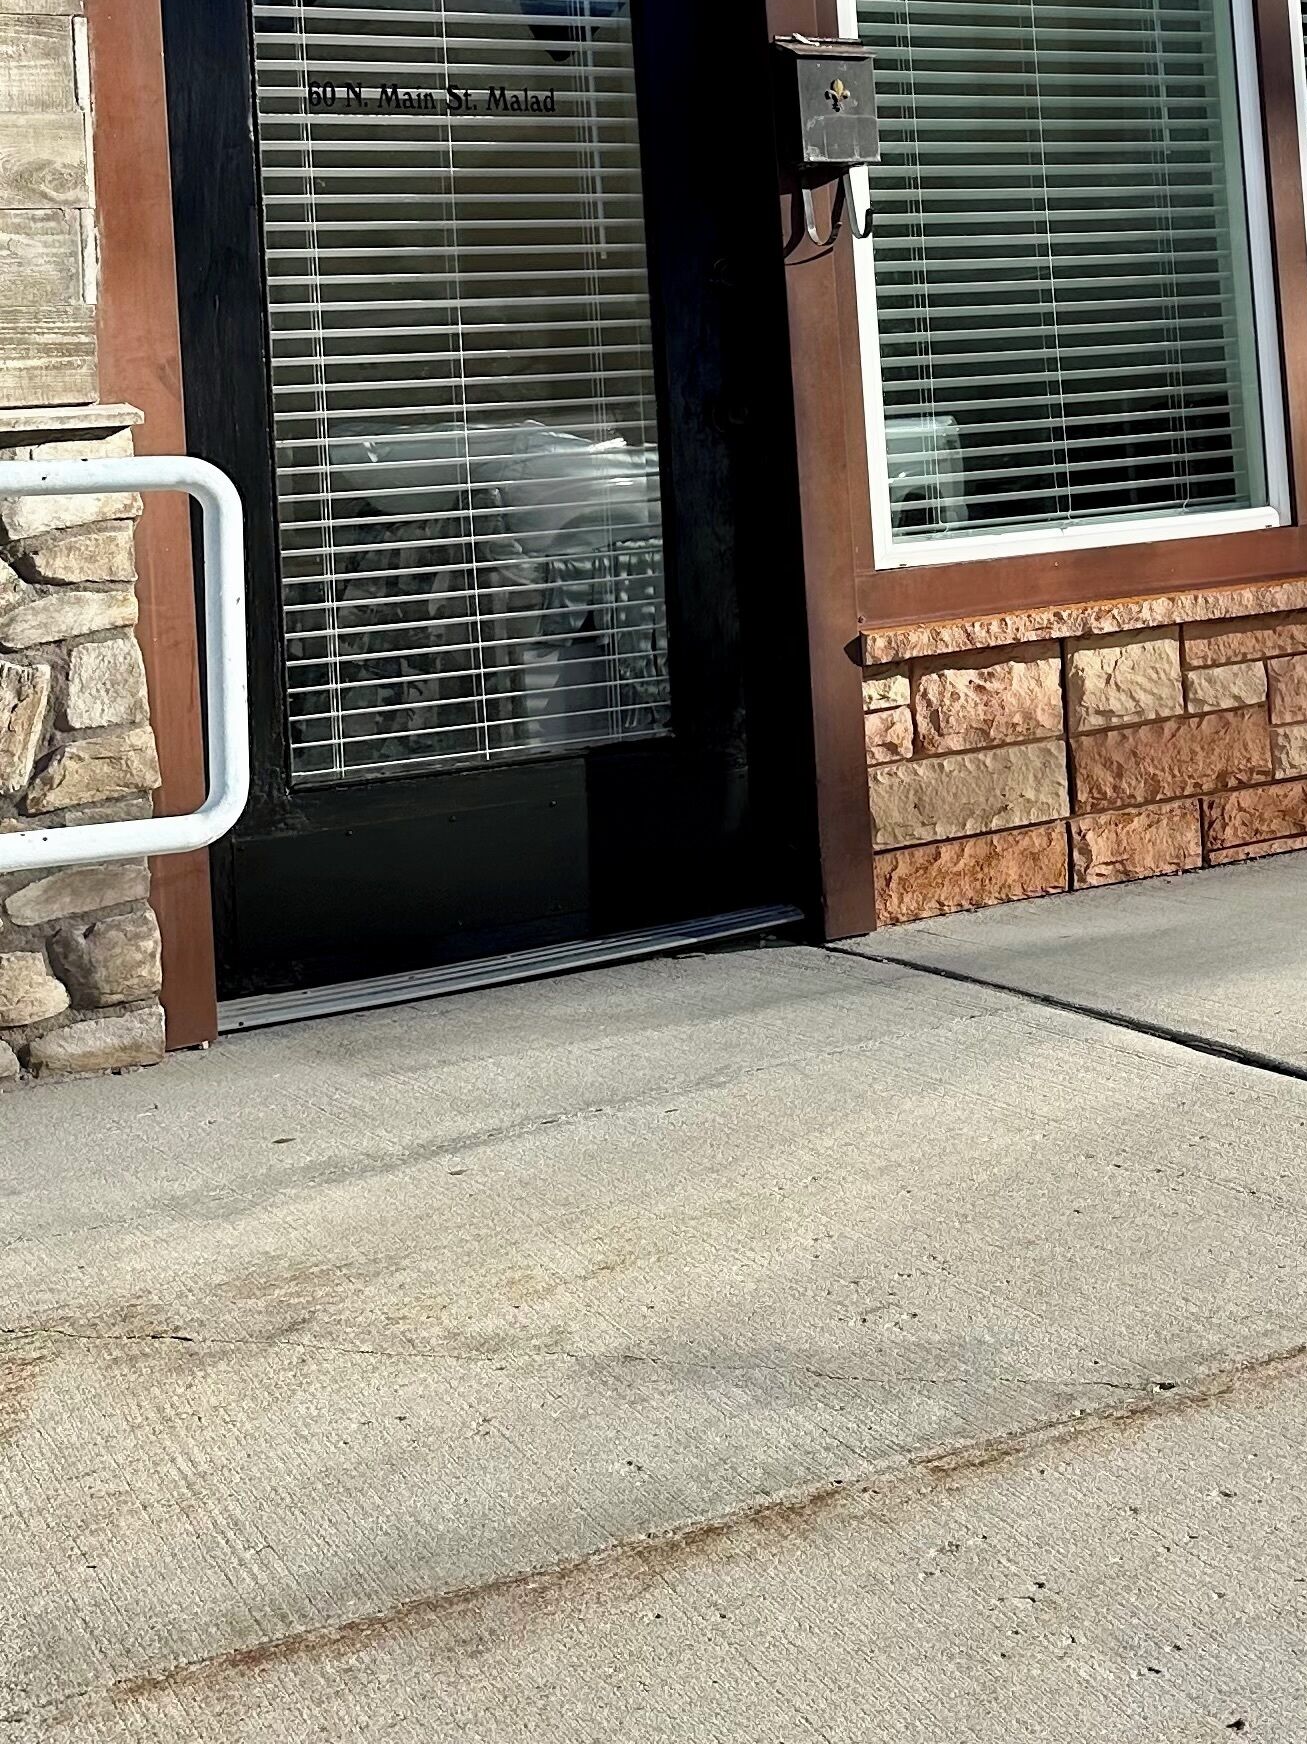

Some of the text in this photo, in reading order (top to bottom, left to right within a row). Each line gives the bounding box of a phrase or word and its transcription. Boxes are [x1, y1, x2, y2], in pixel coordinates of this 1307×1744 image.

[308, 81, 555, 113] 60 N. Main St. Malad
